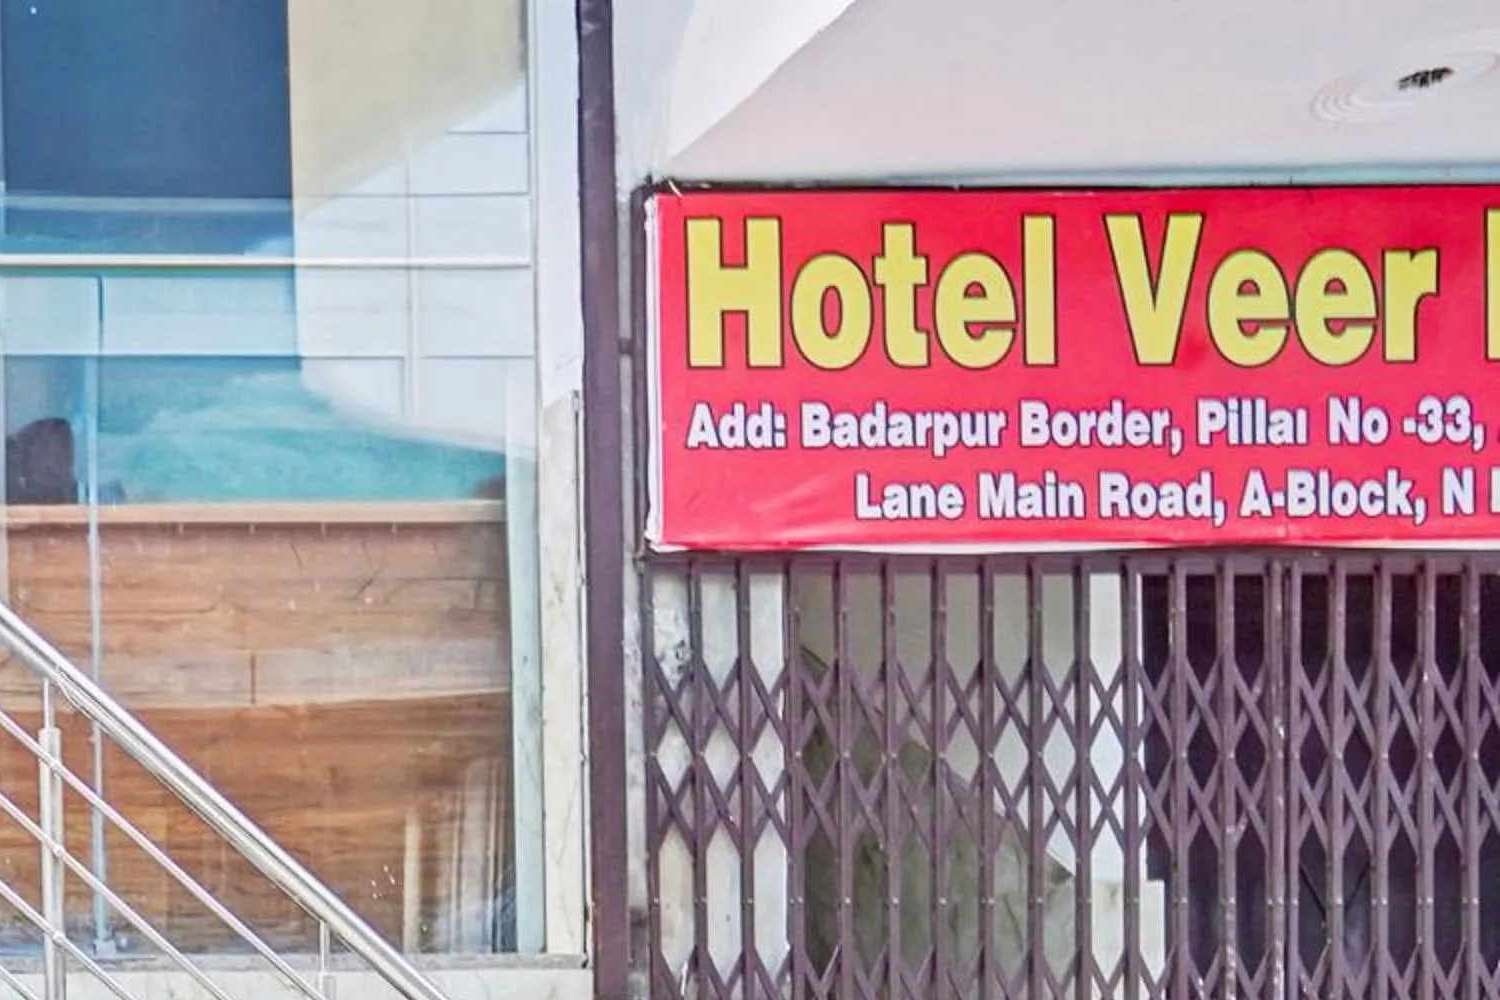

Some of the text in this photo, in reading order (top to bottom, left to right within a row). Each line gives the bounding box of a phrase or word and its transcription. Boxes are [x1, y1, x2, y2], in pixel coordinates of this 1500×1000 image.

[684, 212, 1057, 369] Hotel
[1103, 211, 1439, 368] Veer
[686, 401, 787, 449] Add:
[801, 400, 1008, 457] Badarpur
[1019, 399, 1183, 456] Border,
[1328, 396, 1390, 444] No
[1403, 395, 1485, 452] -33,
[854, 472, 965, 520] Lane
[977, 470, 1086, 519] Main
[1099, 471, 1226, 527] Road,
[1240, 468, 1427, 525] A-Block,
[1442, 467, 1475, 516] N
